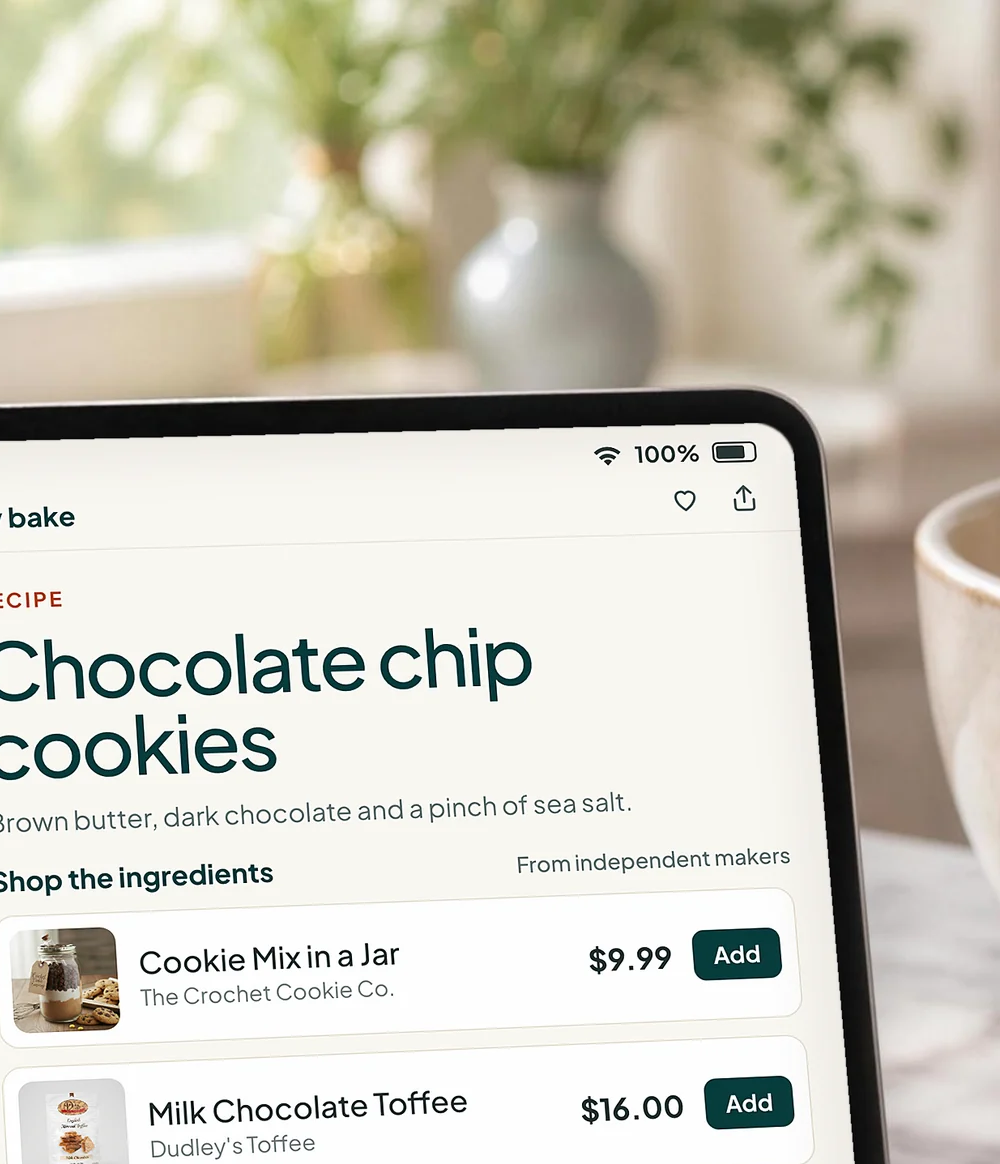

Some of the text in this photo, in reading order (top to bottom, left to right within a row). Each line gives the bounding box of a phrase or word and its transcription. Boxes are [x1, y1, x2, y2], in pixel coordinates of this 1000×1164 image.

[634, 444, 700, 464] 100%
[8, 505, 76, 529] bake
[379, 627, 533, 703] chip
[74, 809, 158, 832] butter,
[163, 805, 220, 828] dark
[224, 801, 352, 826] chocolate
[357, 798, 404, 821] and
[409, 803, 423, 819] a
[429, 795, 497, 824] pinch
[502, 794, 528, 816] of
[533, 798, 577, 815] sea
[582, 791, 632, 813] salt.
[517, 847, 791, 875] From independent makers
[67, 867, 114, 891] the
[118, 863, 274, 894] ingredients
[139, 942, 400, 975] Cookie Mix in a Jar
[589, 945, 672, 976] $9.99
[713, 944, 761, 965] Add
[139, 979, 394, 1007] The Crochet Cookie Co.
[148, 1089, 468, 1127] Milk Chocolate Toffee
[581, 1094, 684, 1126] $16.00
[725, 1092, 773, 1114] Add
[150, 1134, 316, 1161] Dudley's Toffee
